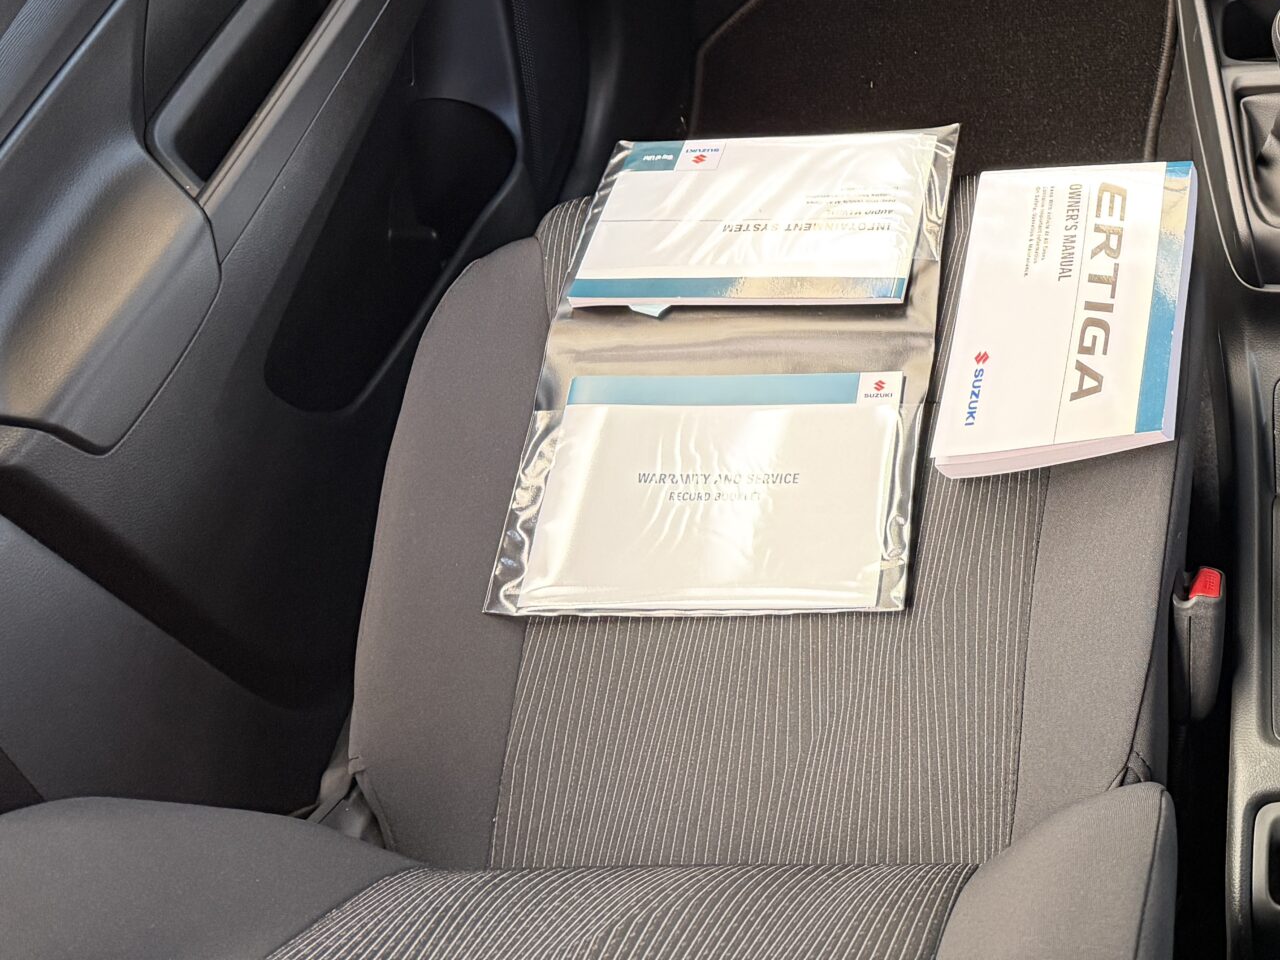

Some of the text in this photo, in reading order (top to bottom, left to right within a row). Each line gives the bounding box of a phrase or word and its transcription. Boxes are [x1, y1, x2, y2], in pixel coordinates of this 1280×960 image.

[1057, 183, 1083, 282] OWNER'S MANUAL
[1069, 182, 1127, 402] ERTIGA
[964, 368, 985, 427] SUZUKI
[638, 472, 800, 485] WARRANTY AND SERVICE
[668, 491, 711, 502] RECORD
